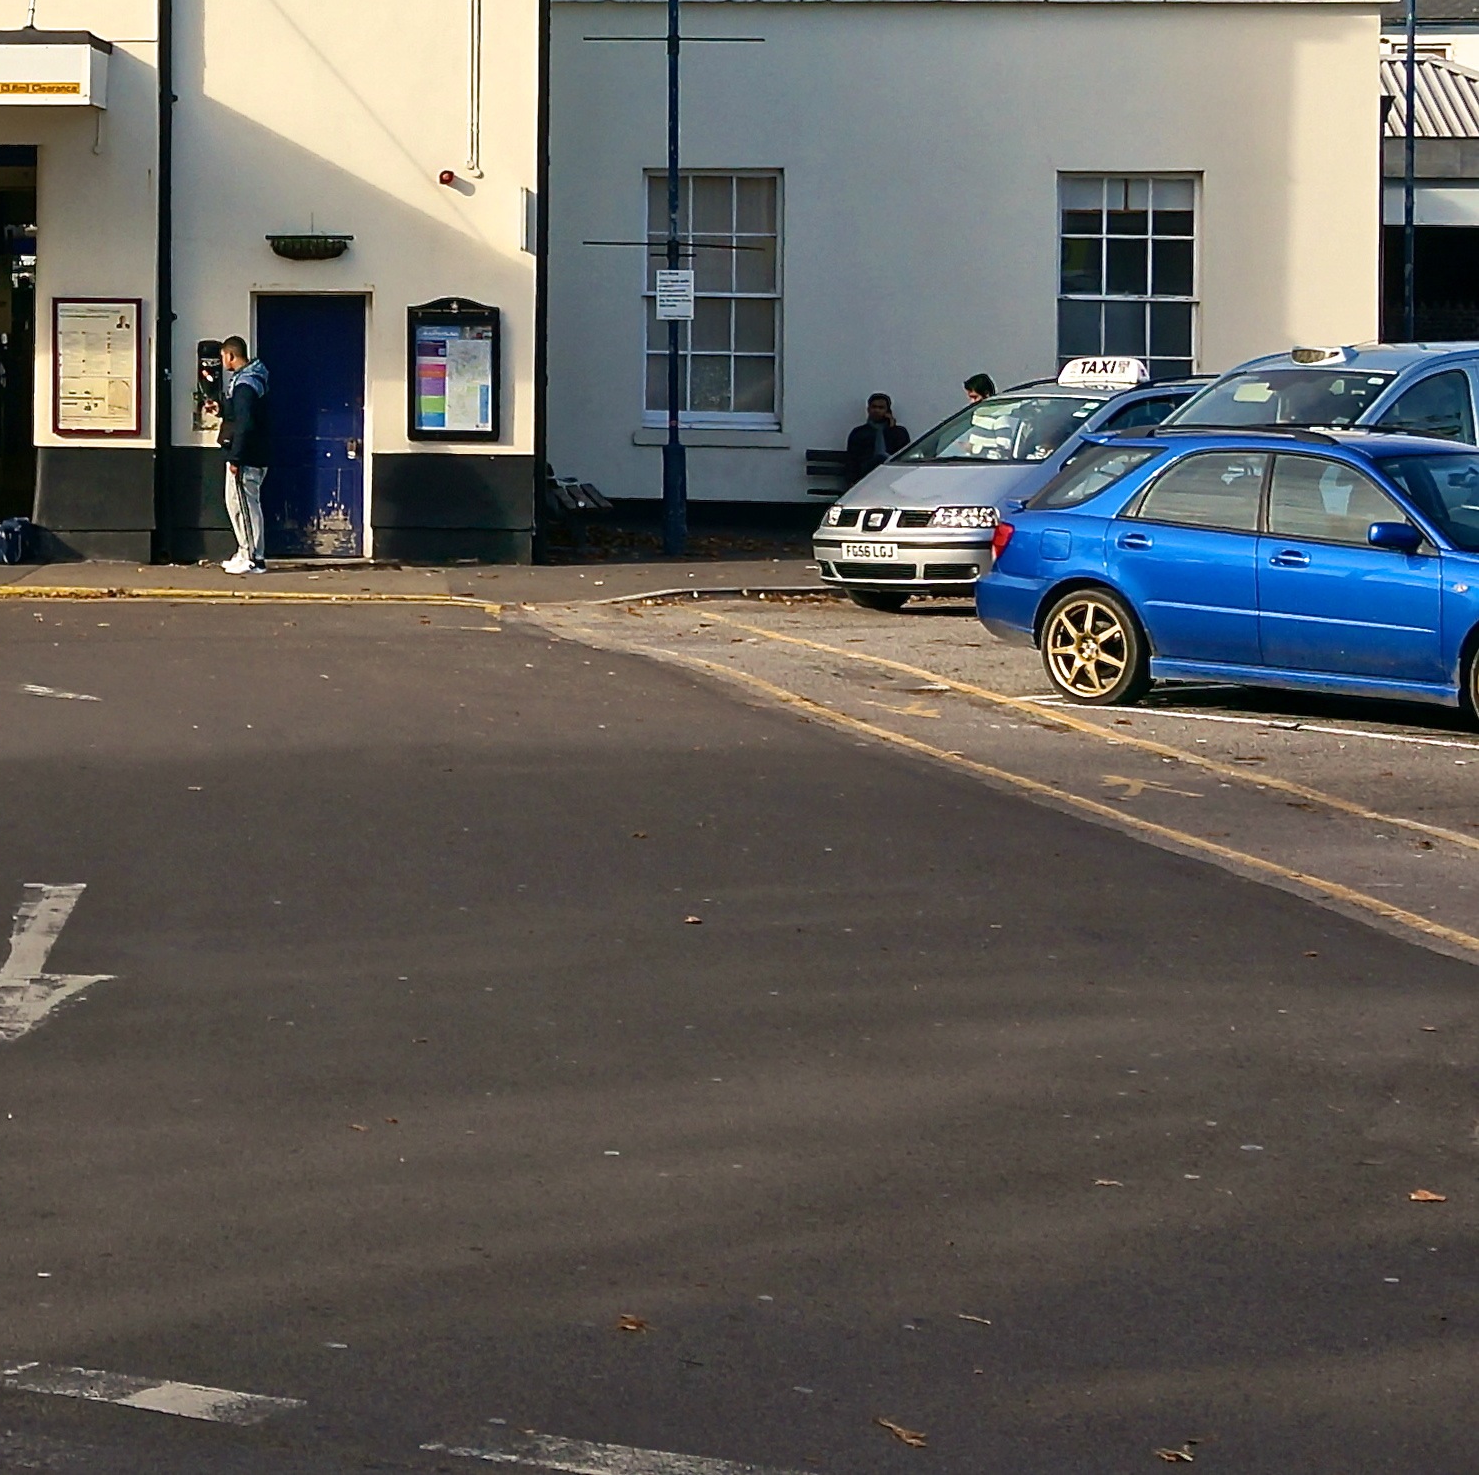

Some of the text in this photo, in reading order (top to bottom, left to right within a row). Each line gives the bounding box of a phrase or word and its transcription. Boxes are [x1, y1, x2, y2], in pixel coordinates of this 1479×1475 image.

[32, 84, 77, 93] Clearance
[1081, 361, 1117, 374] TAXI
[846, 545, 893, 558] FG56 LGJ
